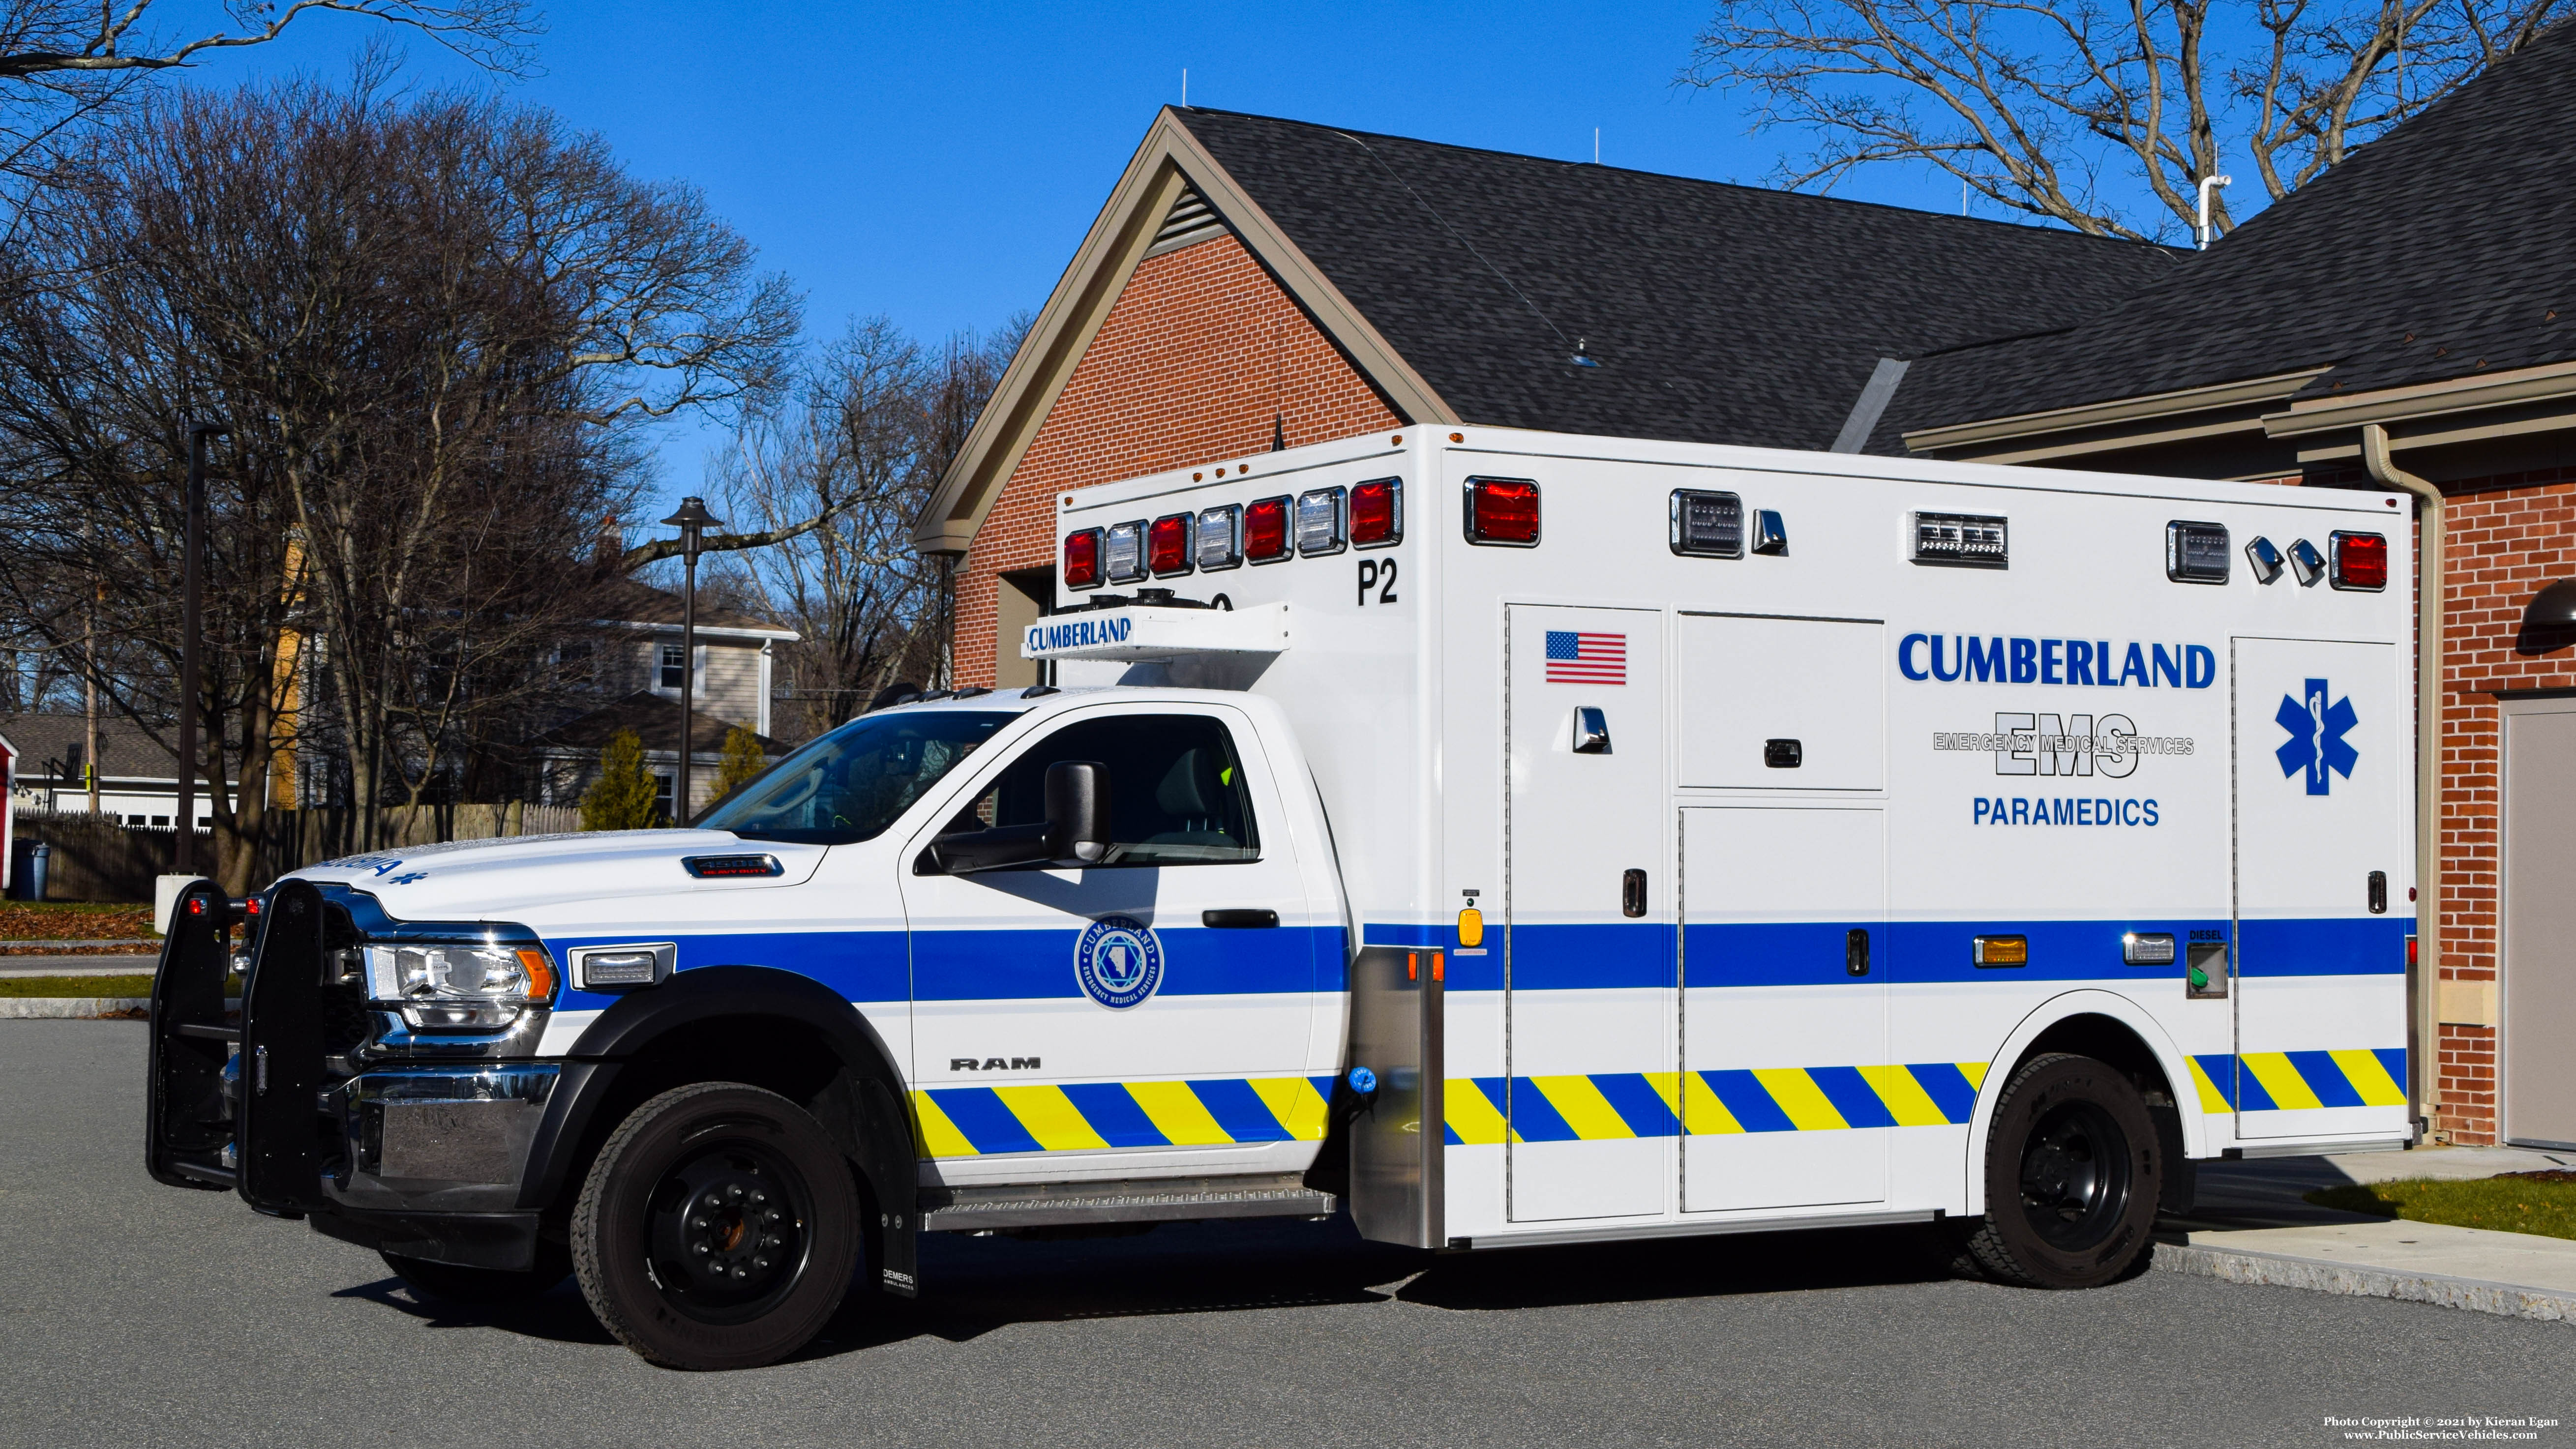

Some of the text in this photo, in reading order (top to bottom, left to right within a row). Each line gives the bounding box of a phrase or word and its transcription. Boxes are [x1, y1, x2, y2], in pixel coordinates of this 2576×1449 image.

[1358, 557, 1398, 607] P2
[1028, 617, 1132, 652] CUMBERLAND
[1898, 632, 2216, 689] CUMBERLAND
[1933, 732, 2194, 755] EMERGENCY MEDICAL SERVICES
[1995, 712, 2138, 778] EMS
[1973, 797, 2159, 827] PARAMEDICS
[699, 859, 762, 868] 4500
[1082, 918, 1155, 954] CUMBERLAND
[2189, 930, 2223, 940] DIESEL
[1082, 966, 1156, 1004] EMERGENCY MEDICAL SERVICES
[950, 1057, 1041, 1071] RAM
[883, 1269, 913, 1284] DEMERS
[883, 1278, 914, 1291] AMBULANCES
